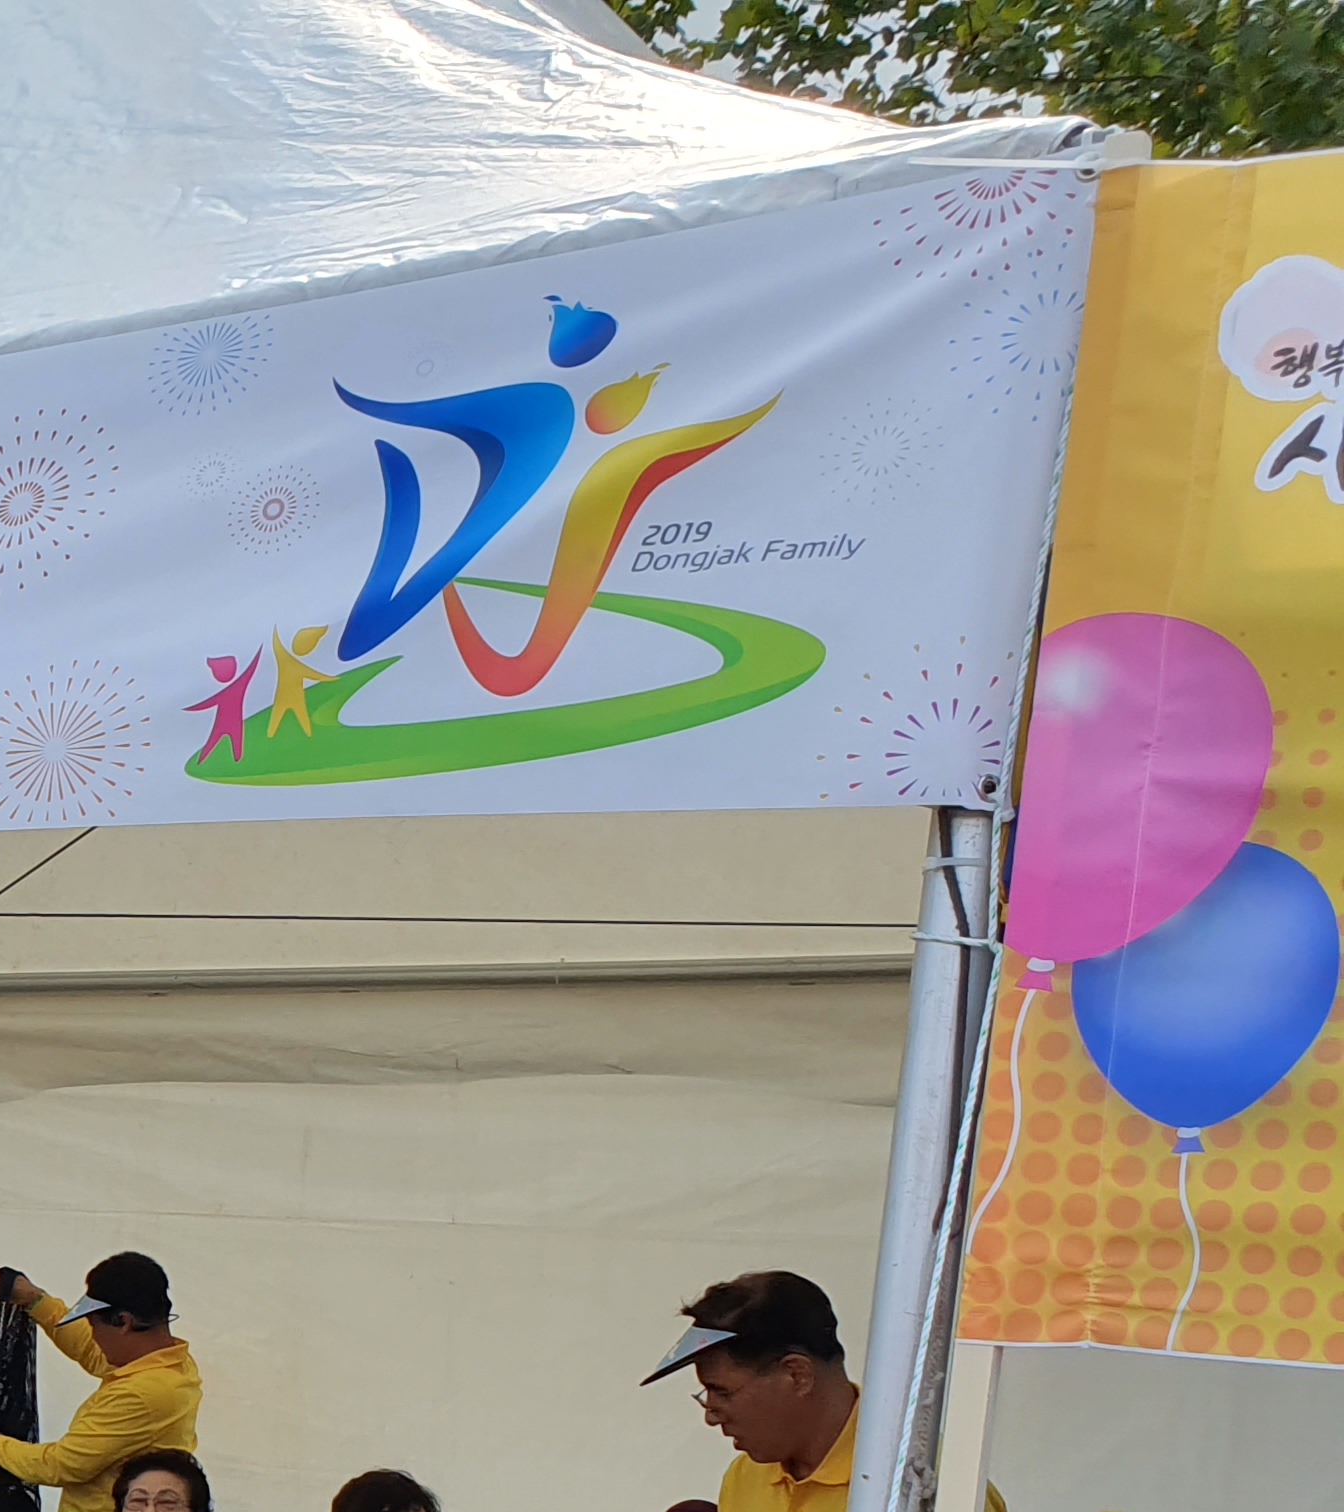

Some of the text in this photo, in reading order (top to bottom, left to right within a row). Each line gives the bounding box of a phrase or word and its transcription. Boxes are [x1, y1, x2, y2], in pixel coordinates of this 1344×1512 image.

[641, 520, 713, 547] 2019
[630, 533, 867, 573] Dongjak Family
